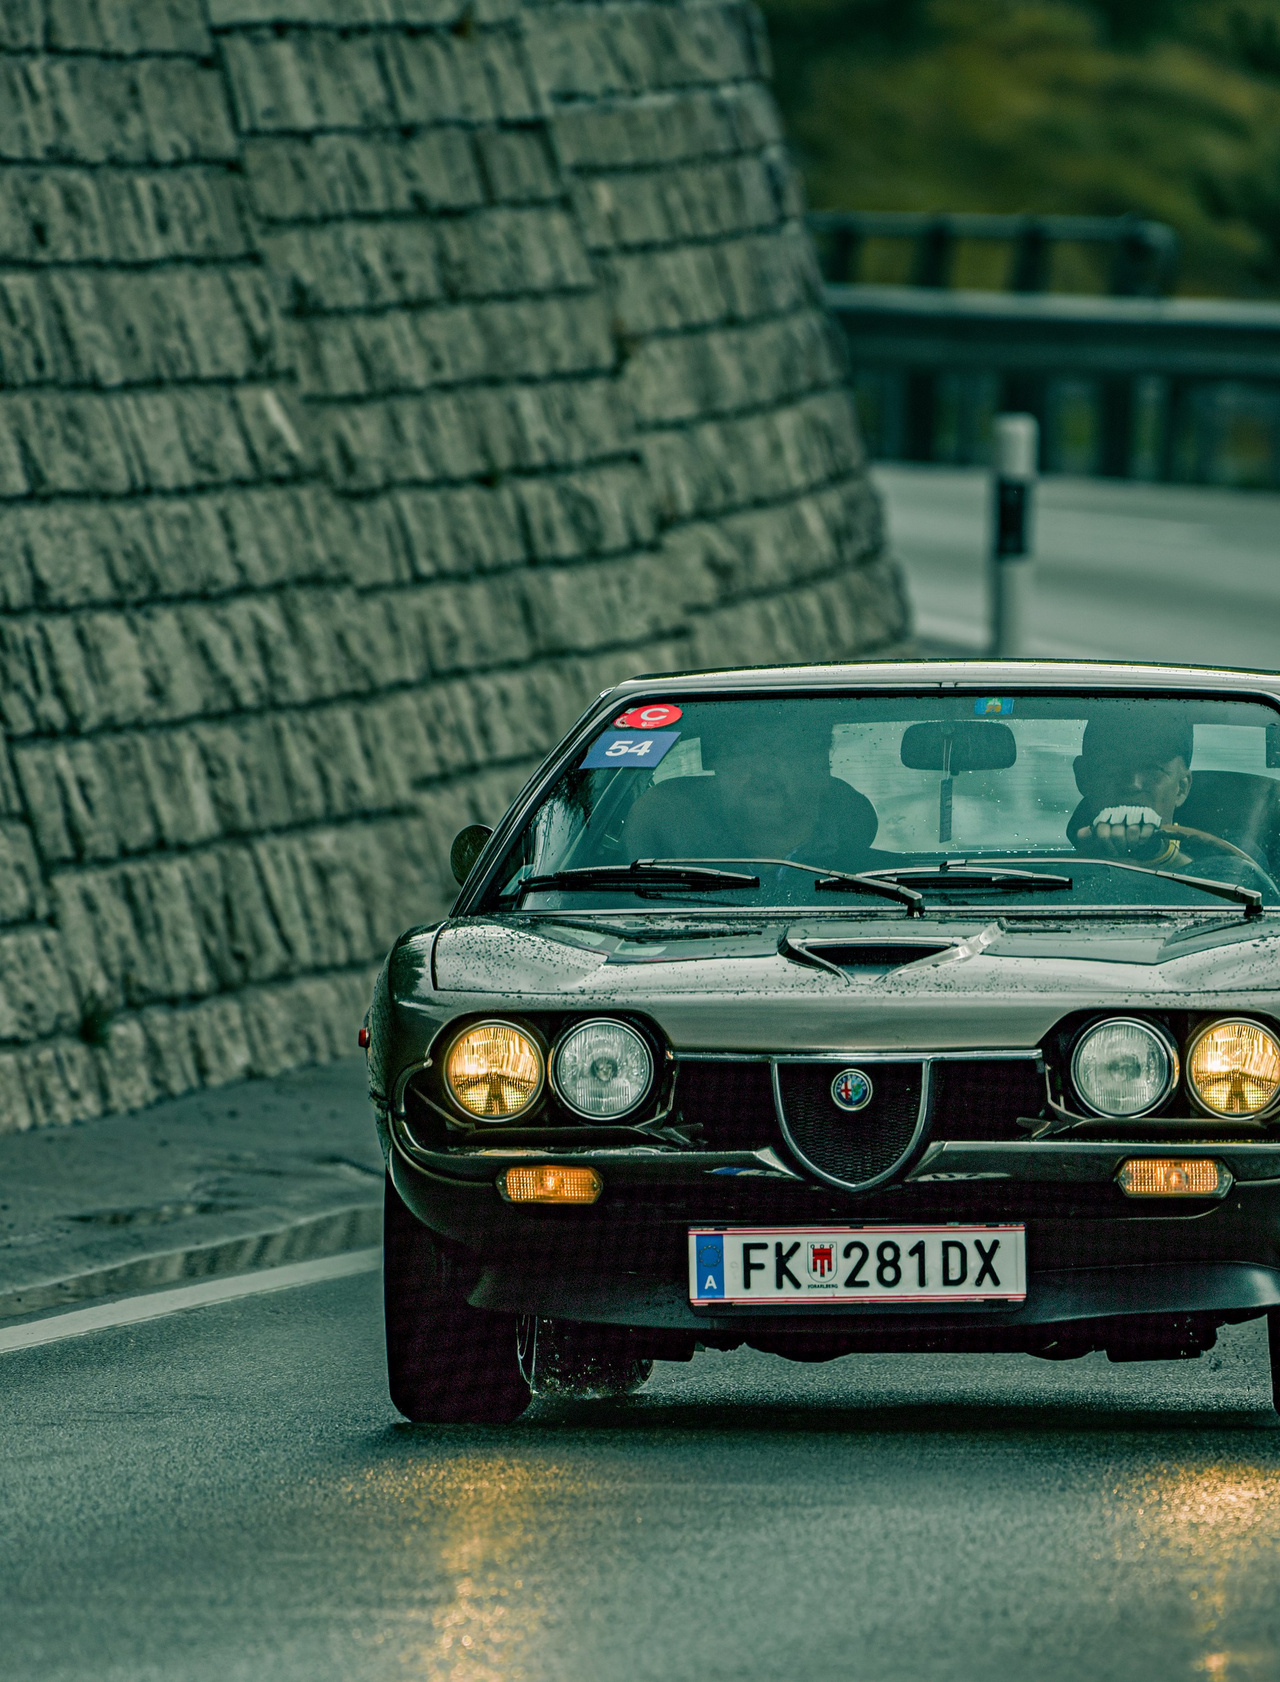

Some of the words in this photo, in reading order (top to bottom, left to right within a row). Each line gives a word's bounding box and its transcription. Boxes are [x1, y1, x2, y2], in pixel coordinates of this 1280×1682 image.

[641, 708, 669, 720] C
[605, 741, 653, 756] 54
[743, 1242, 801, 1289] FK
[704, 1275, 717, 1290] A
